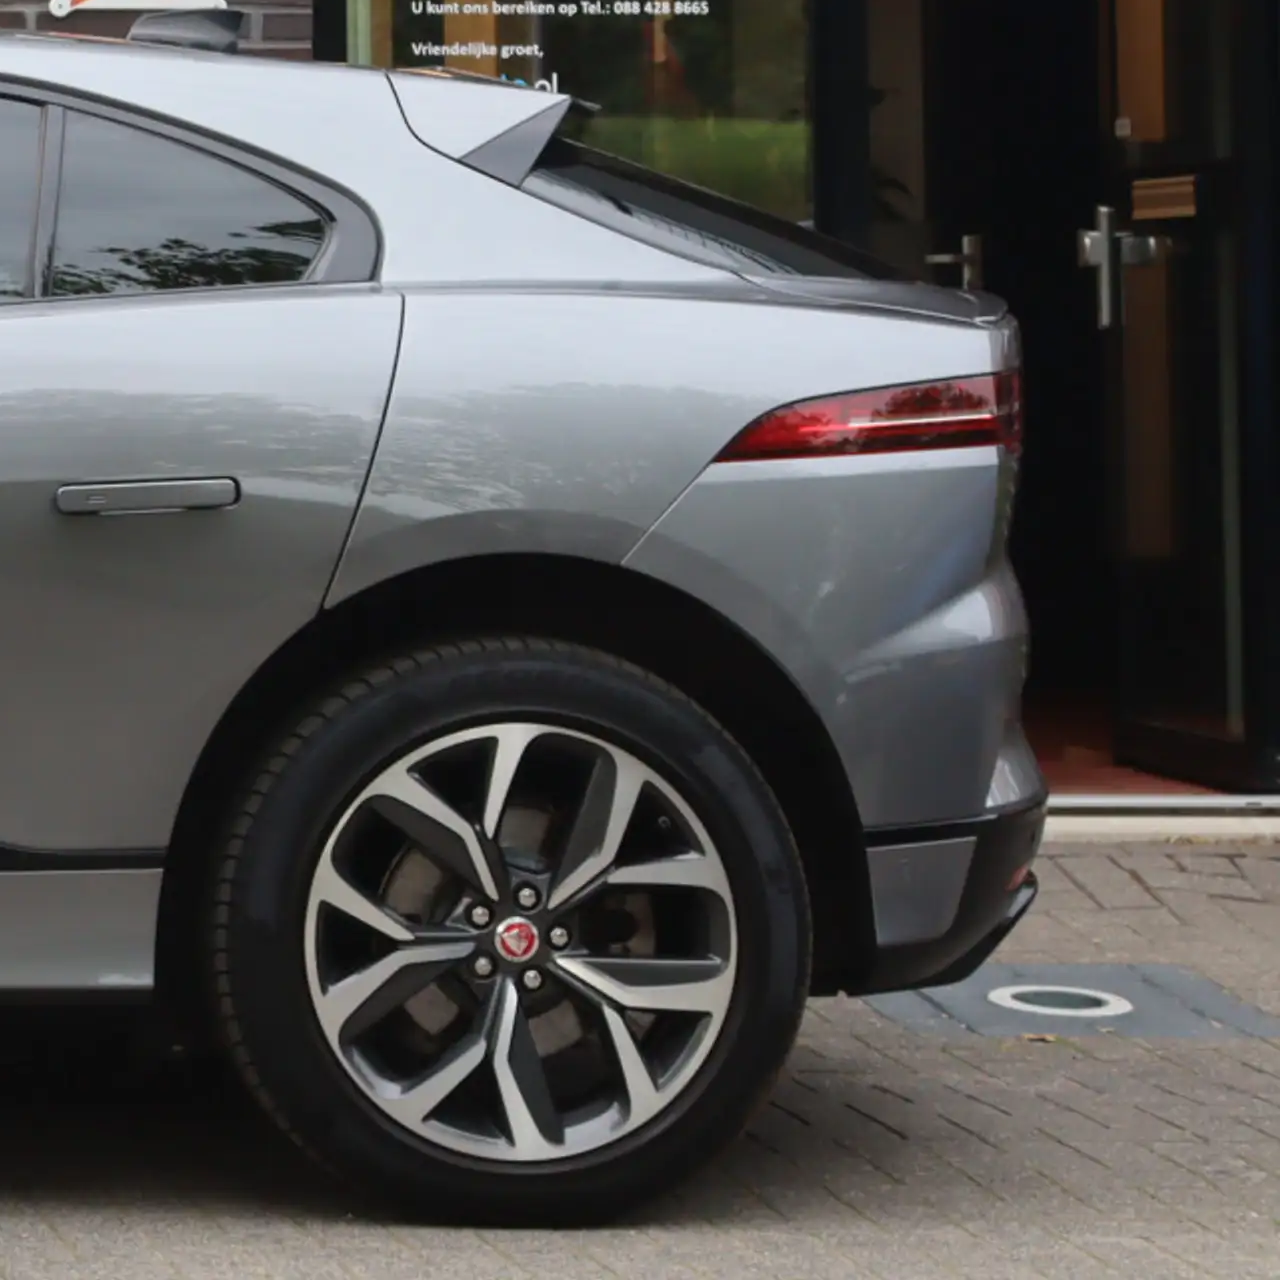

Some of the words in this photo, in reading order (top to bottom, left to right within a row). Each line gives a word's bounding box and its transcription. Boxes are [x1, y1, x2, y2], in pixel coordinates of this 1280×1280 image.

[411, 1, 424, 14] U
[427, 1, 459, 14] kunt
[462, 4, 489, 14] ons
[492, 1, 555, 14] bereiken
[558, 4, 578, 17] op
[580, 1, 610, 14] Tel.:
[613, 1, 641, 15] 088
[643, 1, 671, 15] 428
[673, 1, 709, 15] 8665
[411, 42, 498, 58] Vriendelijke
[500, 43, 544, 58] groet,
